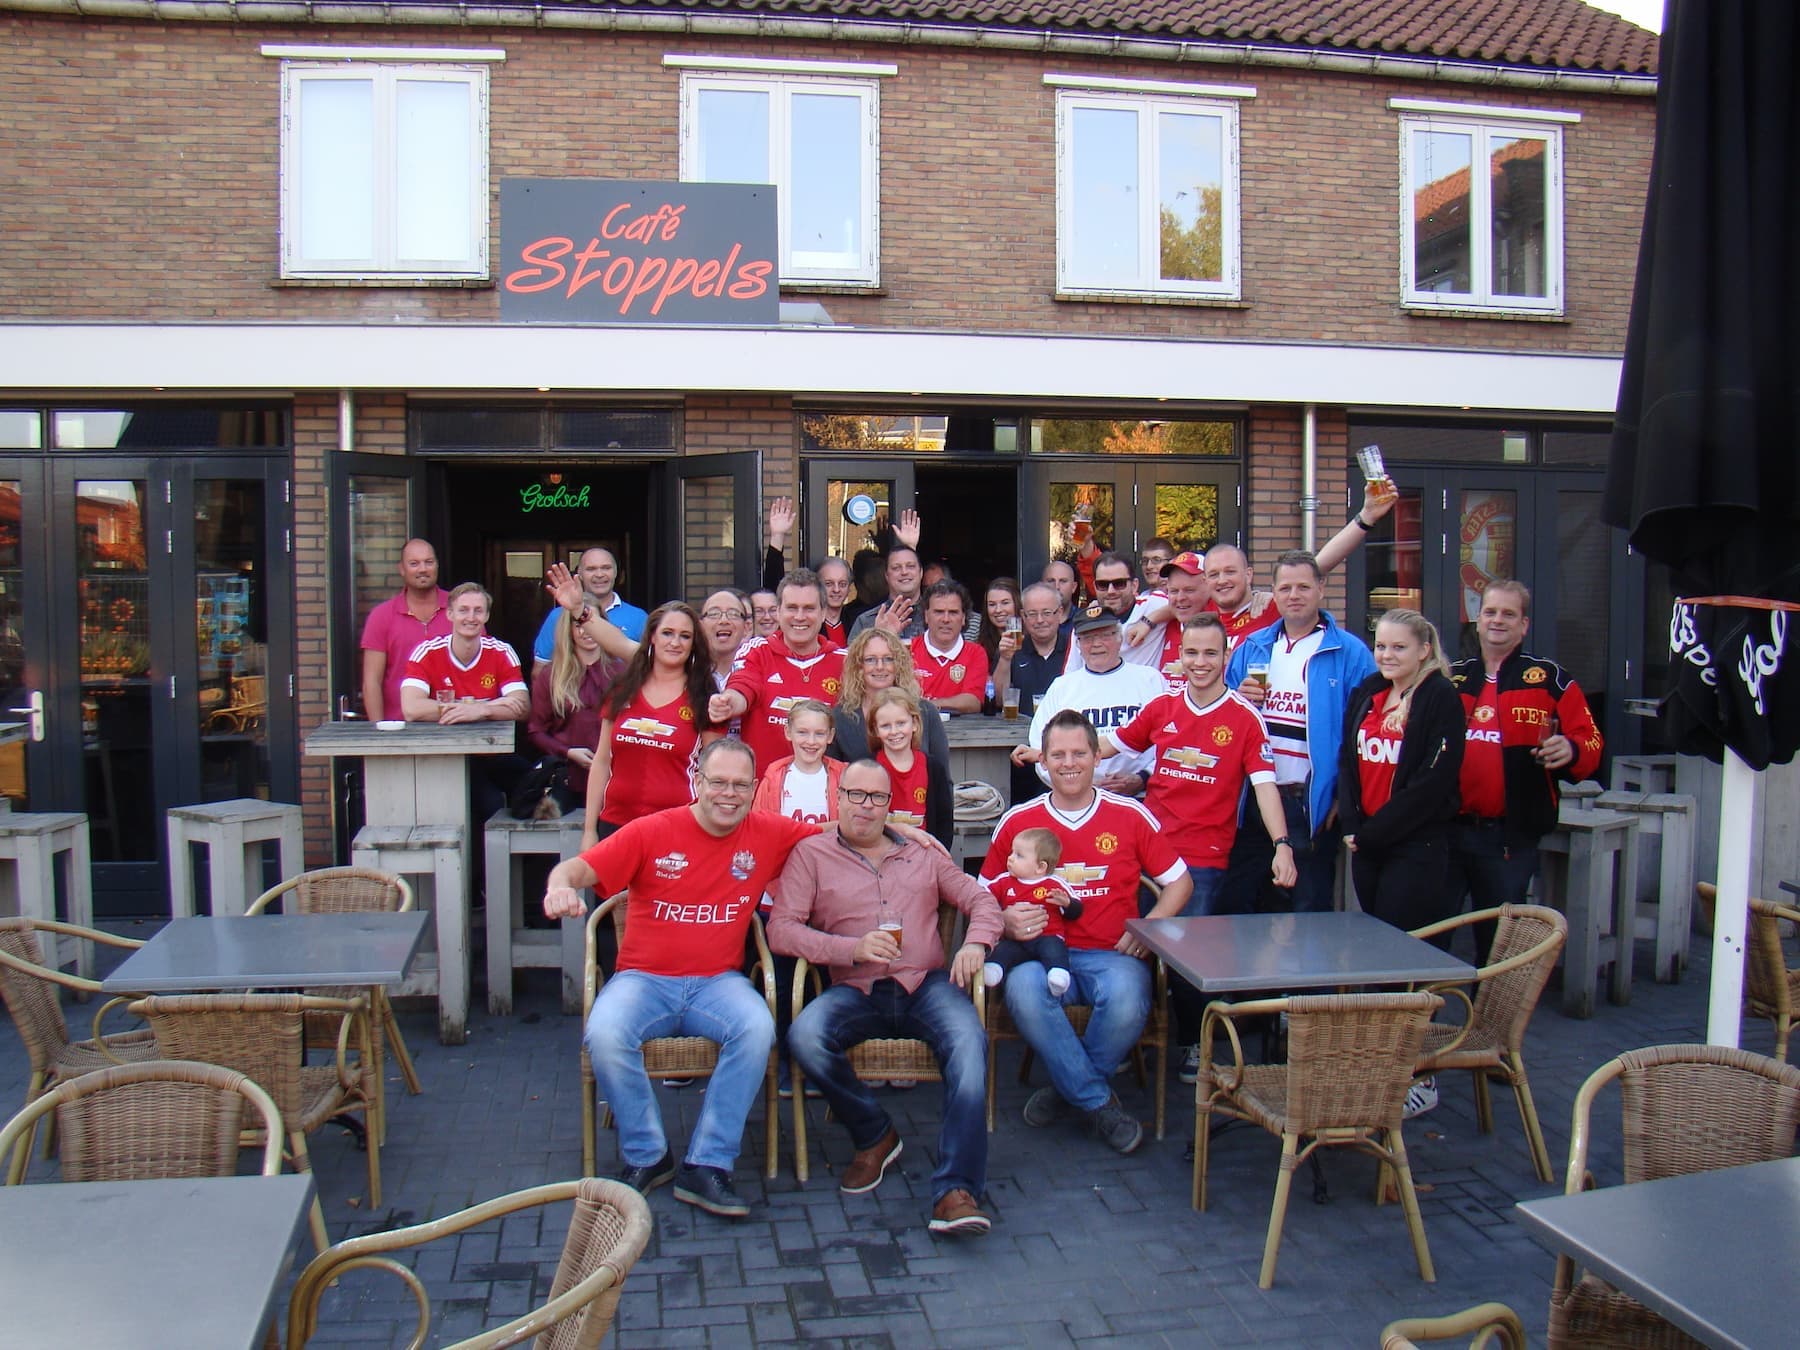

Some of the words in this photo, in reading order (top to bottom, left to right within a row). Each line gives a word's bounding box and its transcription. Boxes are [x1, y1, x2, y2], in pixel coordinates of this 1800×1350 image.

[601, 203, 686, 245] Café
[505, 236, 773, 315] Stoppels
[520, 484, 590, 512] Grolsch
[1264, 690, 1303, 701] HARP
[1265, 700, 1306, 715] WCAM
[616, 734, 675, 750] CHEVROLET
[1357, 728, 1402, 764] AON
[1159, 767, 1217, 785] CHEVROLET
[1074, 887, 1110, 898] ROLET
[653, 899, 740, 924] TREBLE
